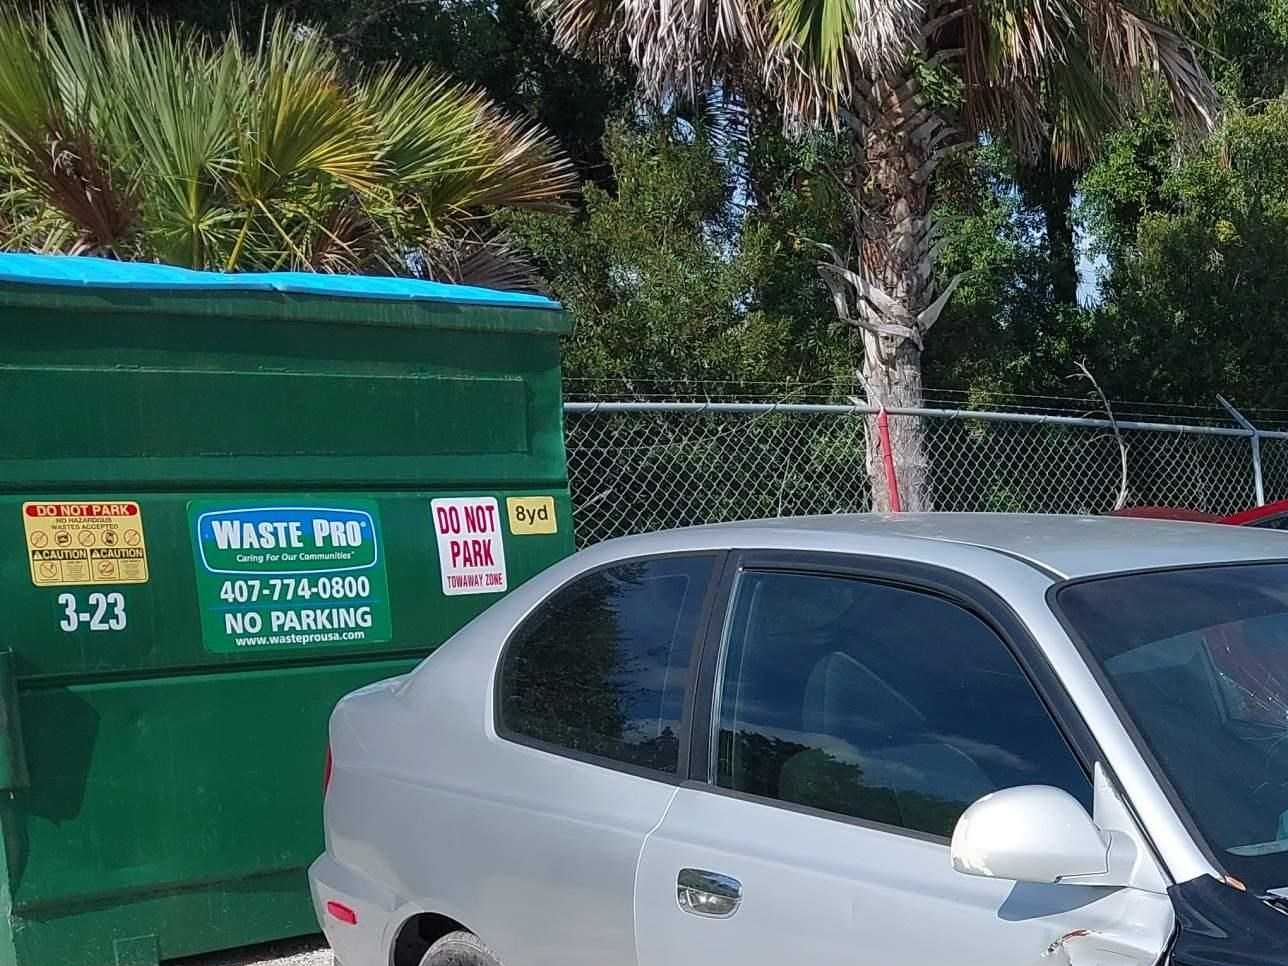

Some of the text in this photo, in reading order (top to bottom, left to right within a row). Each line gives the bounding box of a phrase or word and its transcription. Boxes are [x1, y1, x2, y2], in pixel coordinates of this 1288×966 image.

[36, 504, 130, 517] DO NOT PARK
[436, 505, 495, 535] DO NOT
[515, 504, 549, 525] 8yd
[211, 518, 362, 550] WASTE PRO
[42, 550, 87, 560] CAUTION
[99, 548, 143, 559] CAUTION
[236, 551, 351, 564] Caring For Our Communities
[450, 539, 494, 568] PARK
[220, 575, 370, 603] 407-774-0800
[446, 572, 503, 589] TOWAWAY ZONE
[57, 592, 127, 632] 3-23
[224, 606, 373, 635] NO PARKING
[235, 629, 365, 648] www.wasteprousa.com
